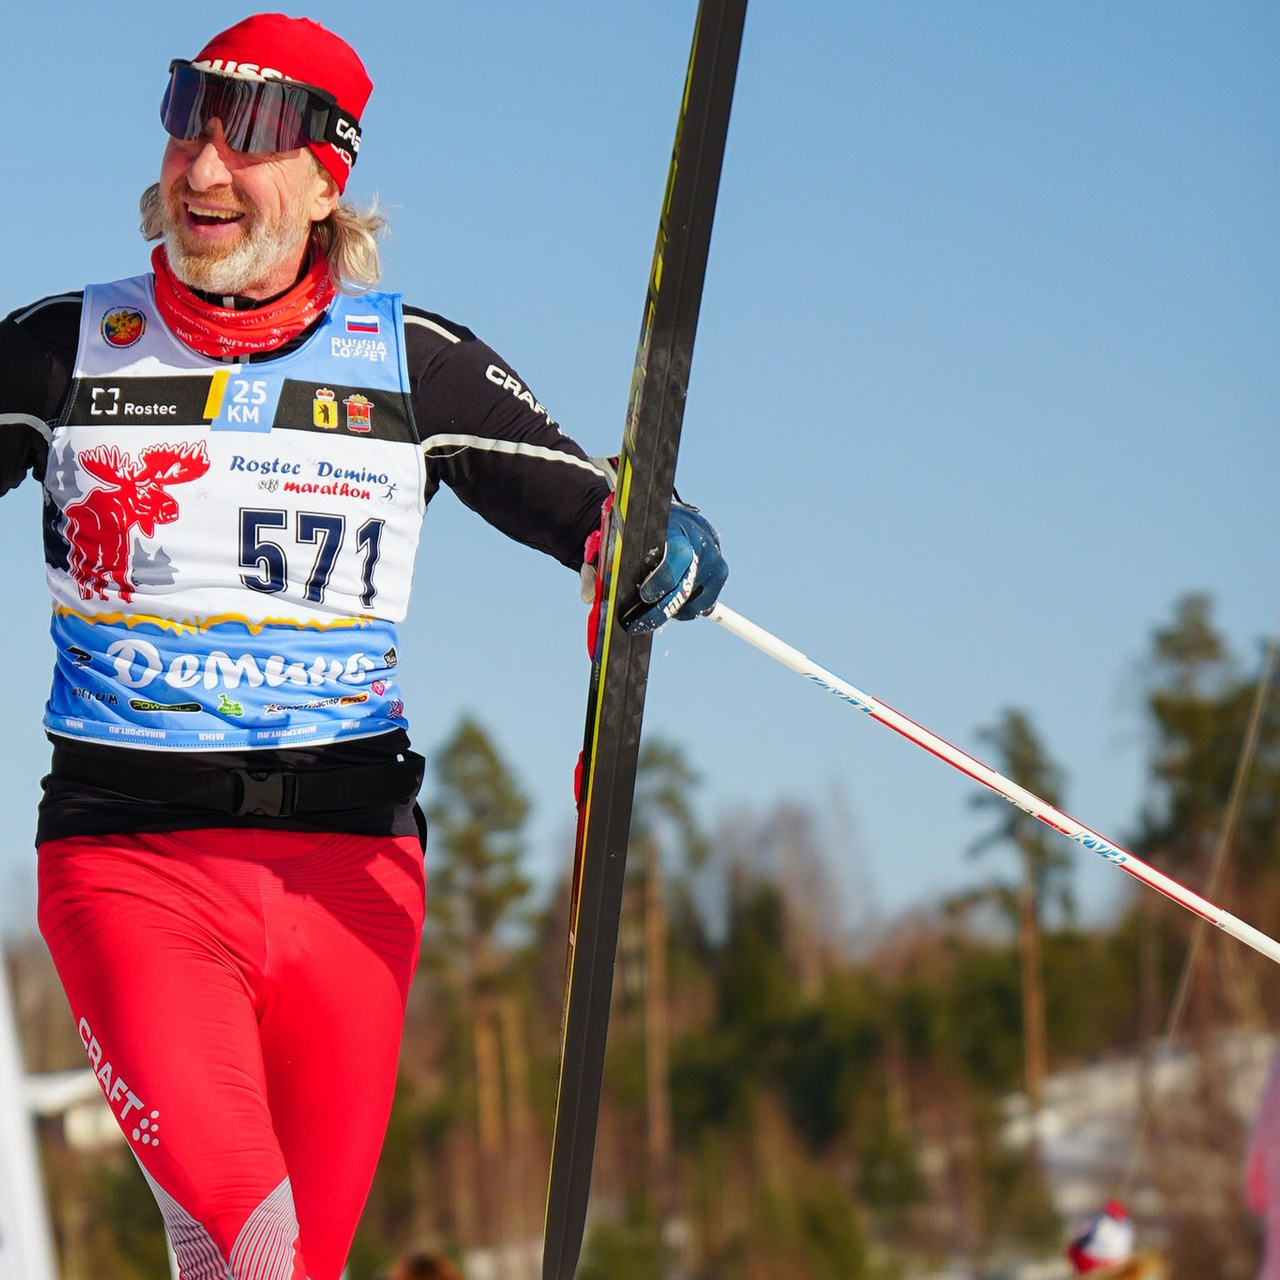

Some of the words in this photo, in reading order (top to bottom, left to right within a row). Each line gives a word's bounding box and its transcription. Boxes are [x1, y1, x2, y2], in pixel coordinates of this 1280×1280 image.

[331, 337, 387, 352] RUSSIA
[232, 379, 268, 405] 25
[124, 402, 177, 415] Rostec
[229, 455, 301, 475] Rostec
[316, 461, 389, 485] Demino
[283, 481, 371, 500] marathon
[238, 507, 386, 610] 571
[78, 1016, 145, 1121] CRAFT
